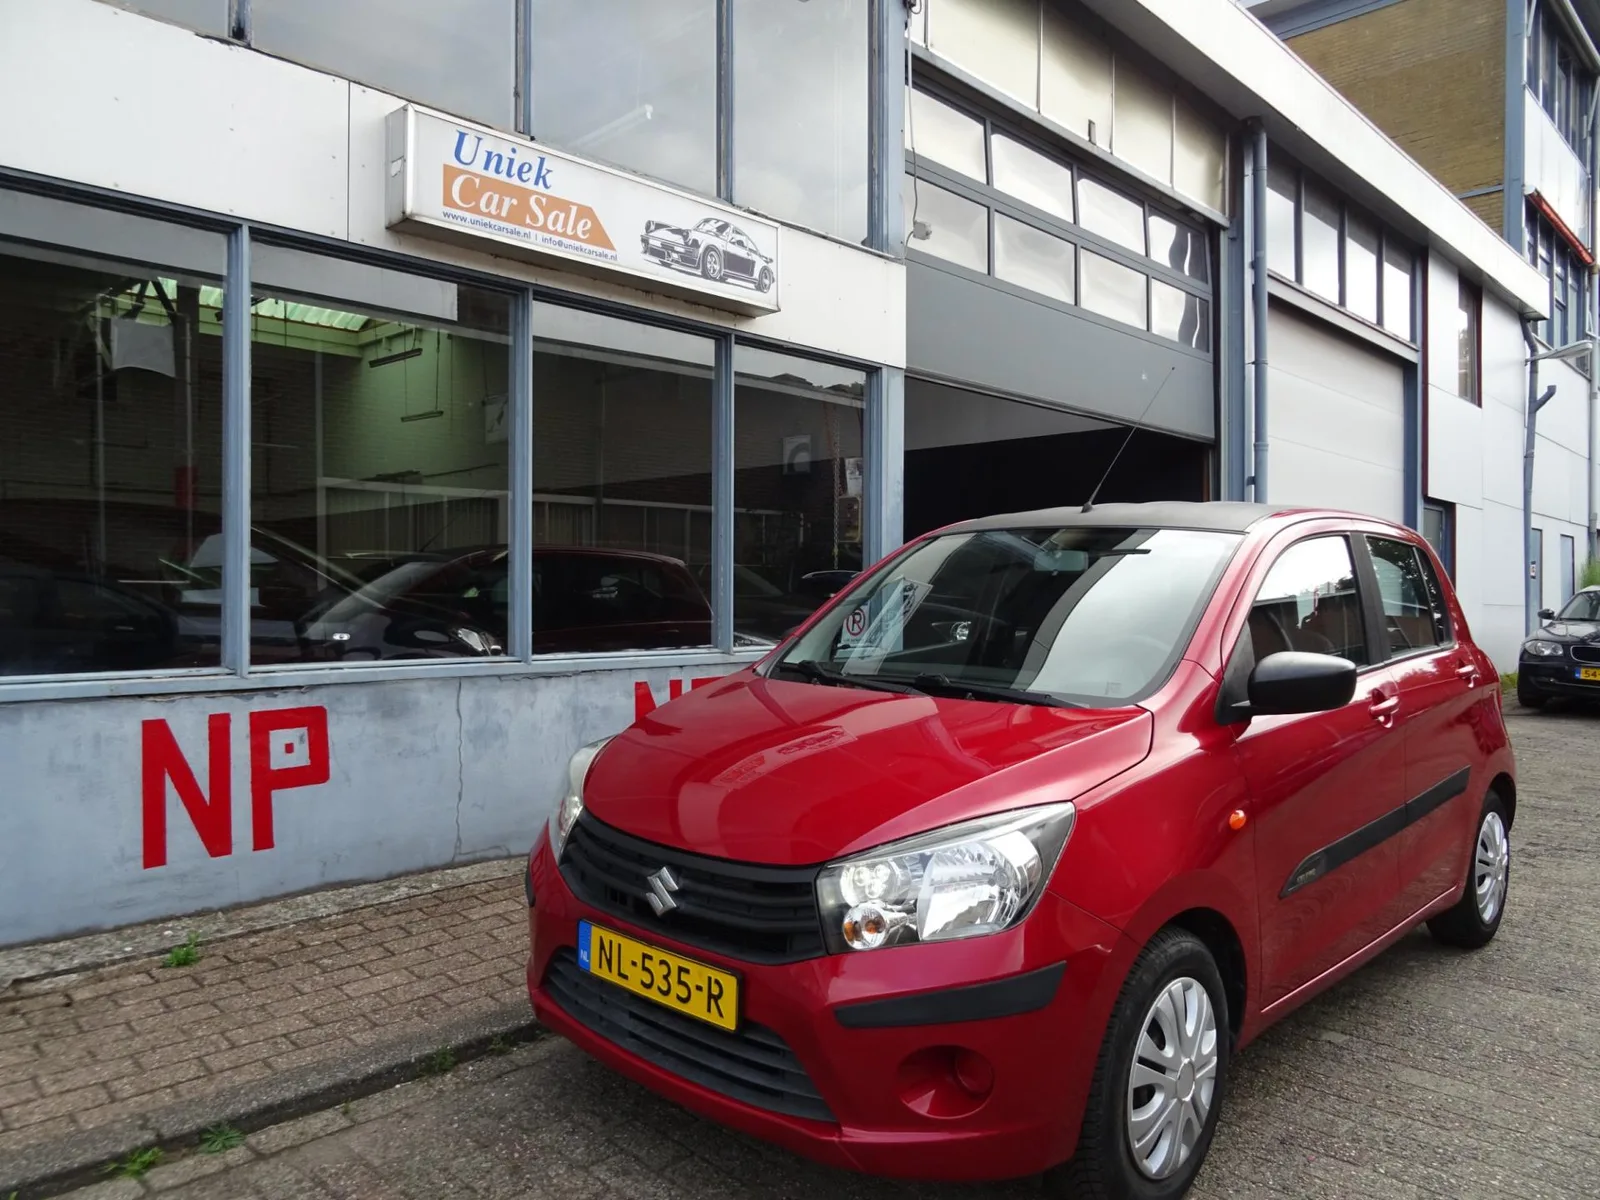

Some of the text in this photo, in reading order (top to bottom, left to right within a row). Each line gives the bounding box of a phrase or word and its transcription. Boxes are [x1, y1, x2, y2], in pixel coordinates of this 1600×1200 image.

[454, 129, 553, 190] Uniek
[442, 210, 532, 240] www.uniekcarsale.nl
[541, 234, 618, 261] info@uniekcarsale.nl
[451, 174, 592, 239] Car Sale
[141, 706, 331, 870] NP
[598, 935, 724, 1018] NL-535-R
